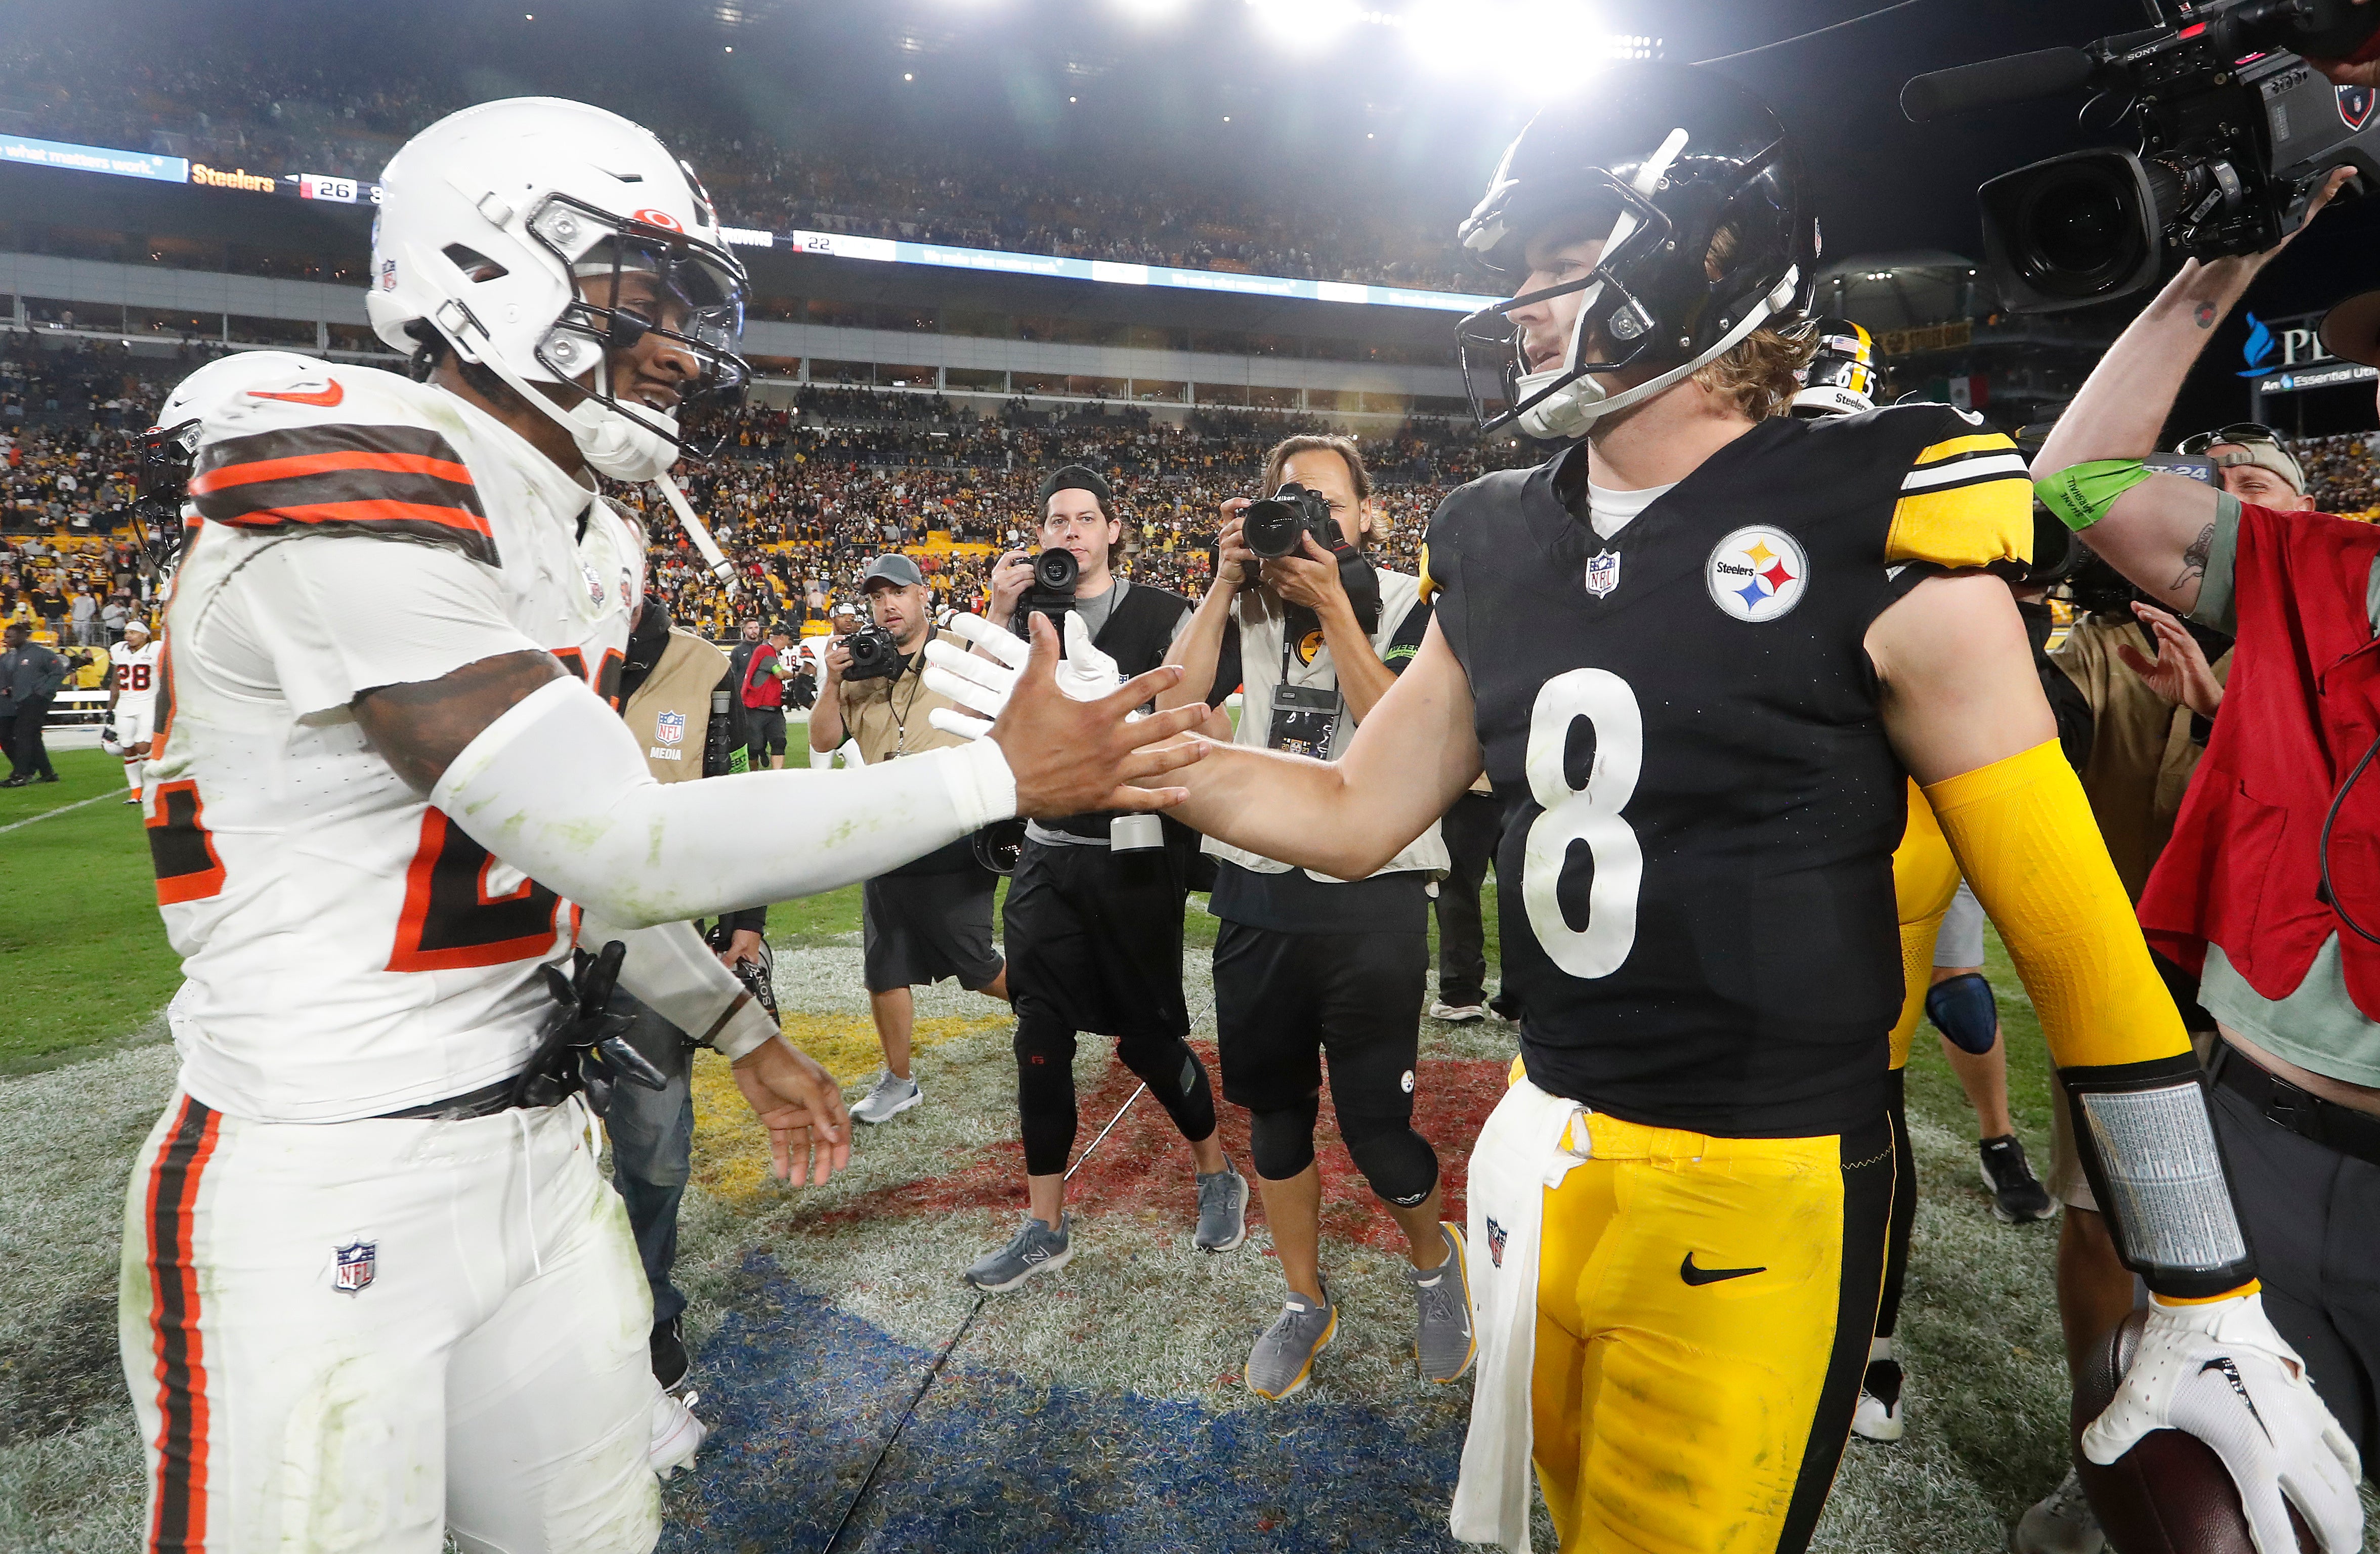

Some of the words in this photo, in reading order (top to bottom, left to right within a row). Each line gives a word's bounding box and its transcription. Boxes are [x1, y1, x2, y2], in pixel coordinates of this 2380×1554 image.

[2128, 46, 2159, 61] SONY
[5, 144, 47, 161] what
[50, 152, 110, 169] matters
[191, 163, 275, 193] Steelers
[320, 182, 350, 198] 26
[809, 237, 830, 250] 22
[2261, 380, 2281, 391] An
[2293, 369, 2352, 387] Essential
[2067, 475, 2095, 514] MARSHALL
[2060, 492, 2084, 517] SHANE
[820, 572, 830, 580] 32
[1717, 562, 1754, 577] Steelers
[1591, 571, 1612, 588] NFL
[786, 655, 797, 666] 18
[116, 664, 151, 691] 28
[659, 724, 679, 741] NFL
[650, 746, 682, 761] MEDIA
[1523, 667, 1643, 979] 8
[341, 1263, 370, 1285] NFL
